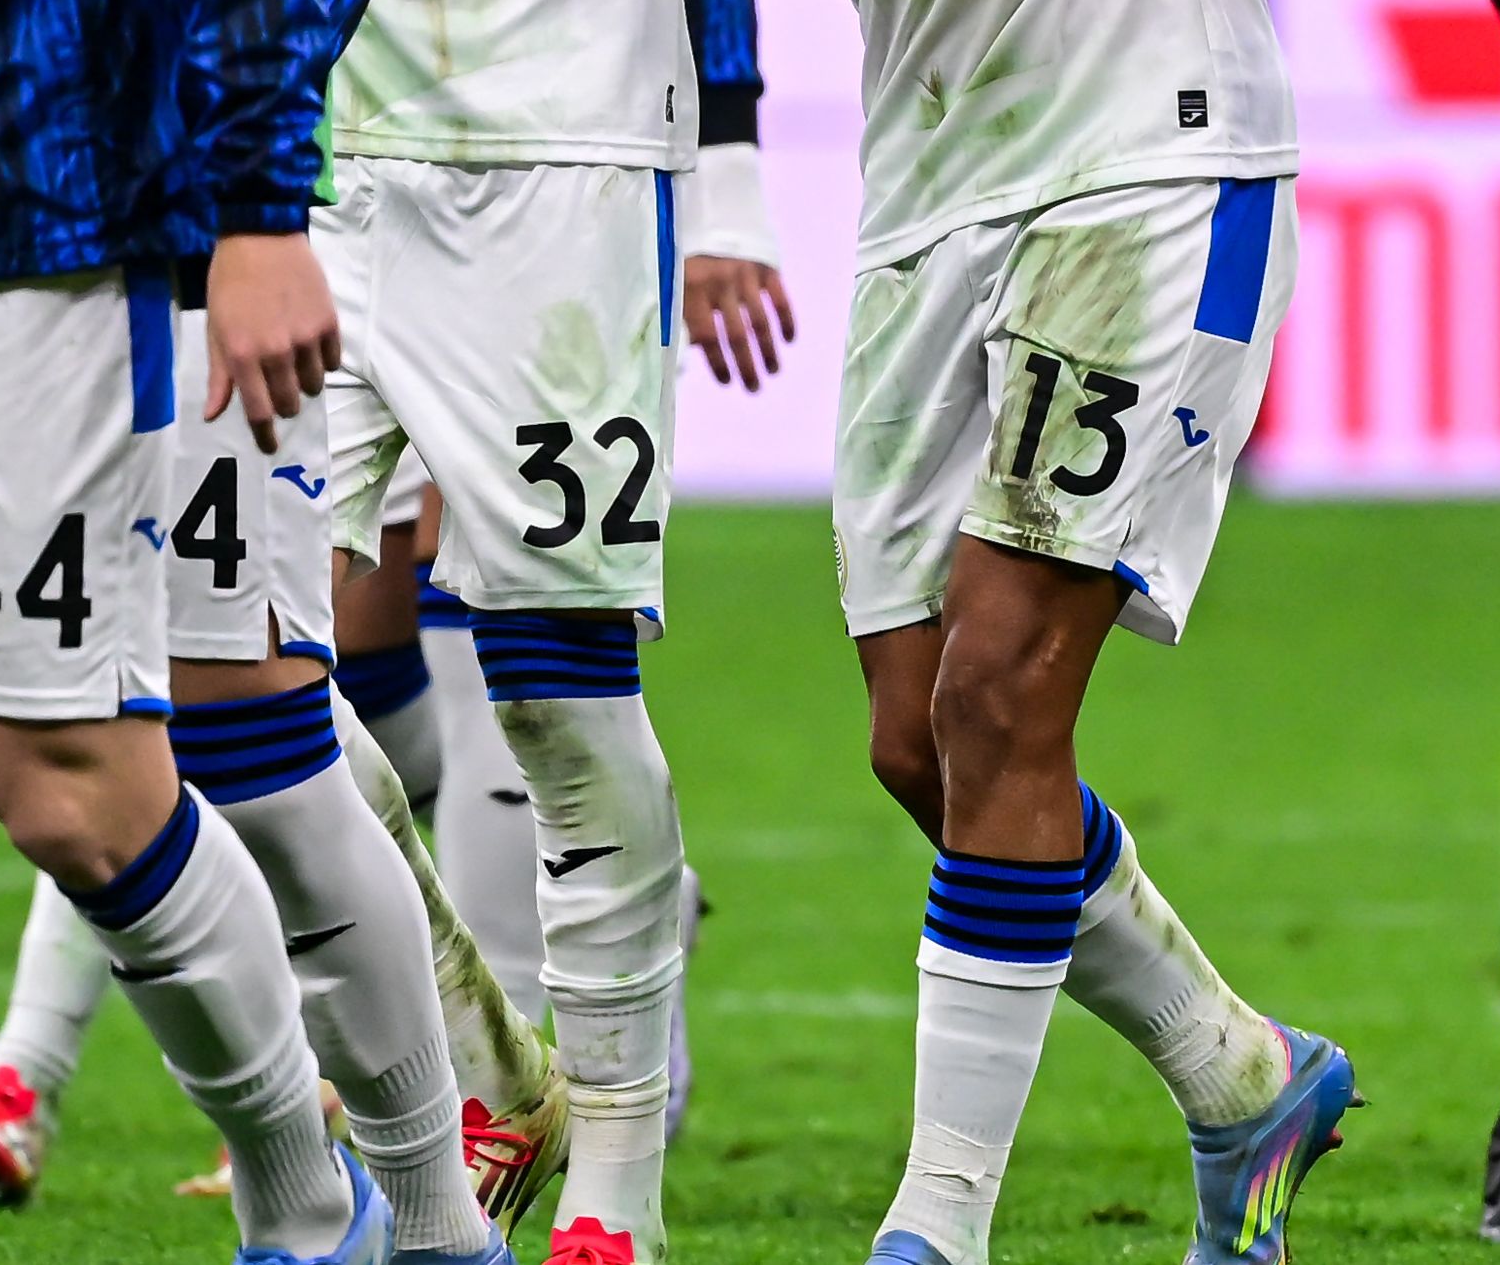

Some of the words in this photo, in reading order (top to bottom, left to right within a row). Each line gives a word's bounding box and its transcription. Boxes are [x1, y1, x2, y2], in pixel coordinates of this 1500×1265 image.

[515, 416, 661, 549] 32
[1009, 352, 1140, 498] 13
[171, 456, 247, 590] 4
